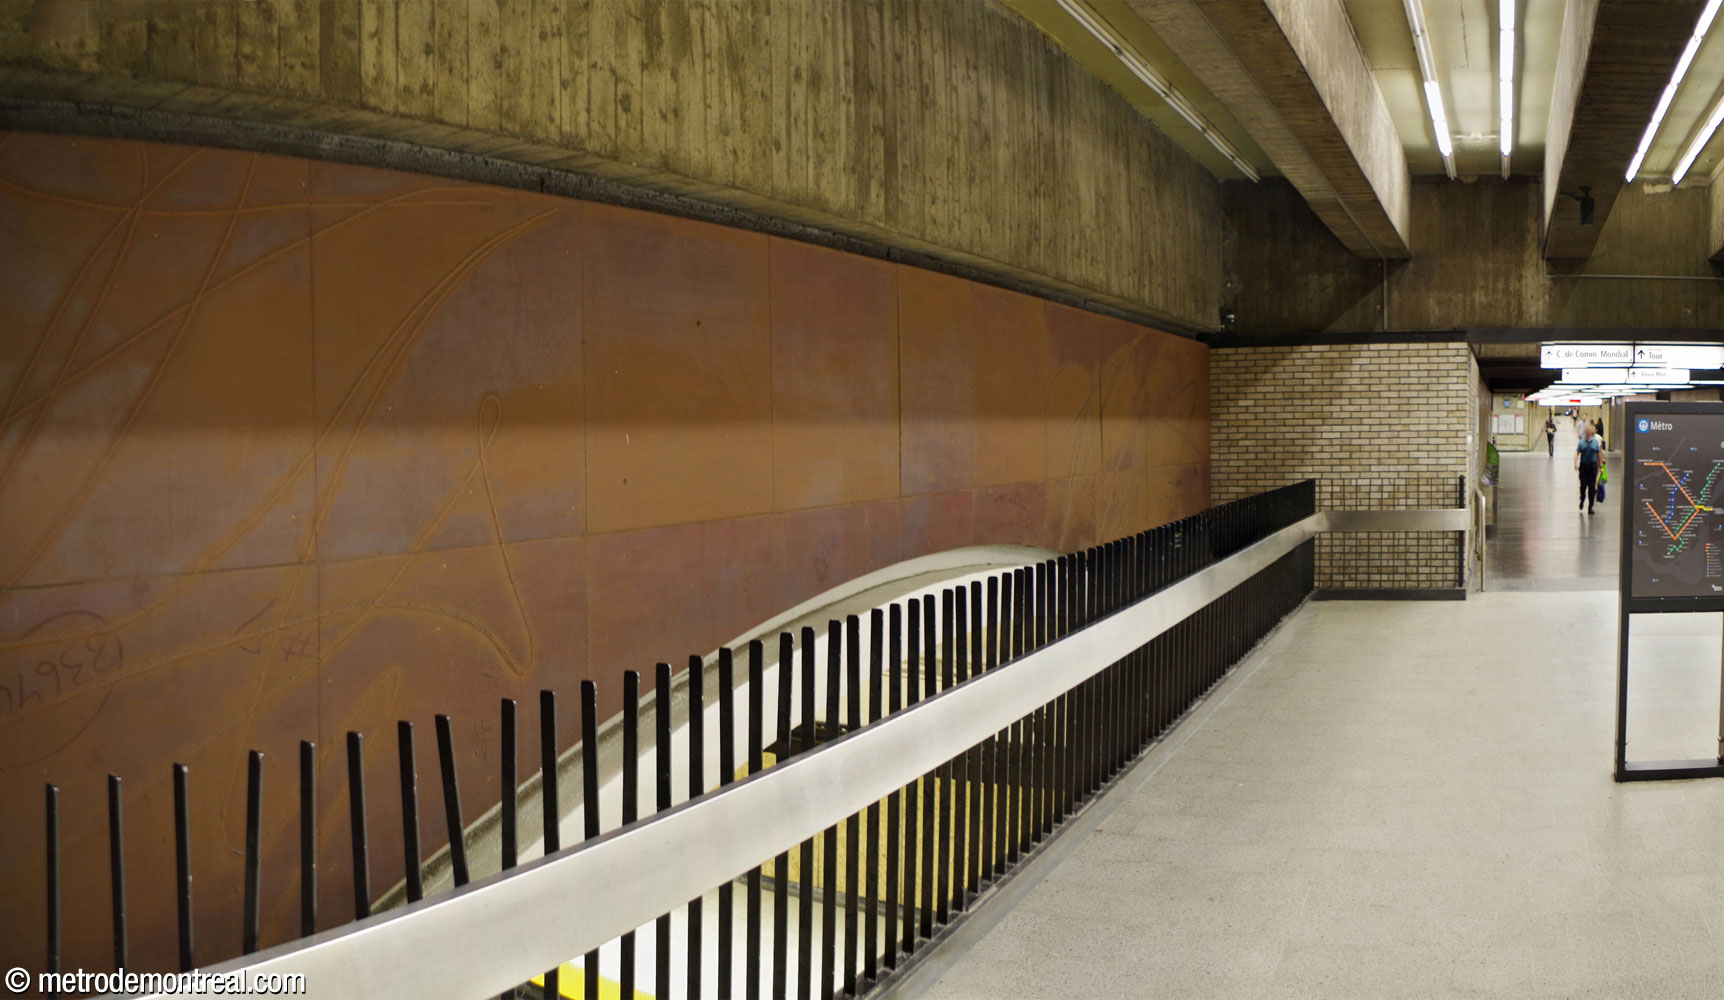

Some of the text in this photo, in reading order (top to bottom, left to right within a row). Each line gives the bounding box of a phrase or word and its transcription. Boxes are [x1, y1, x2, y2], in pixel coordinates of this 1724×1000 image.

[1564, 350, 1574, 358] de
[1600, 350, 1629, 358] Mondial
[1650, 420, 1673, 431] Métro
